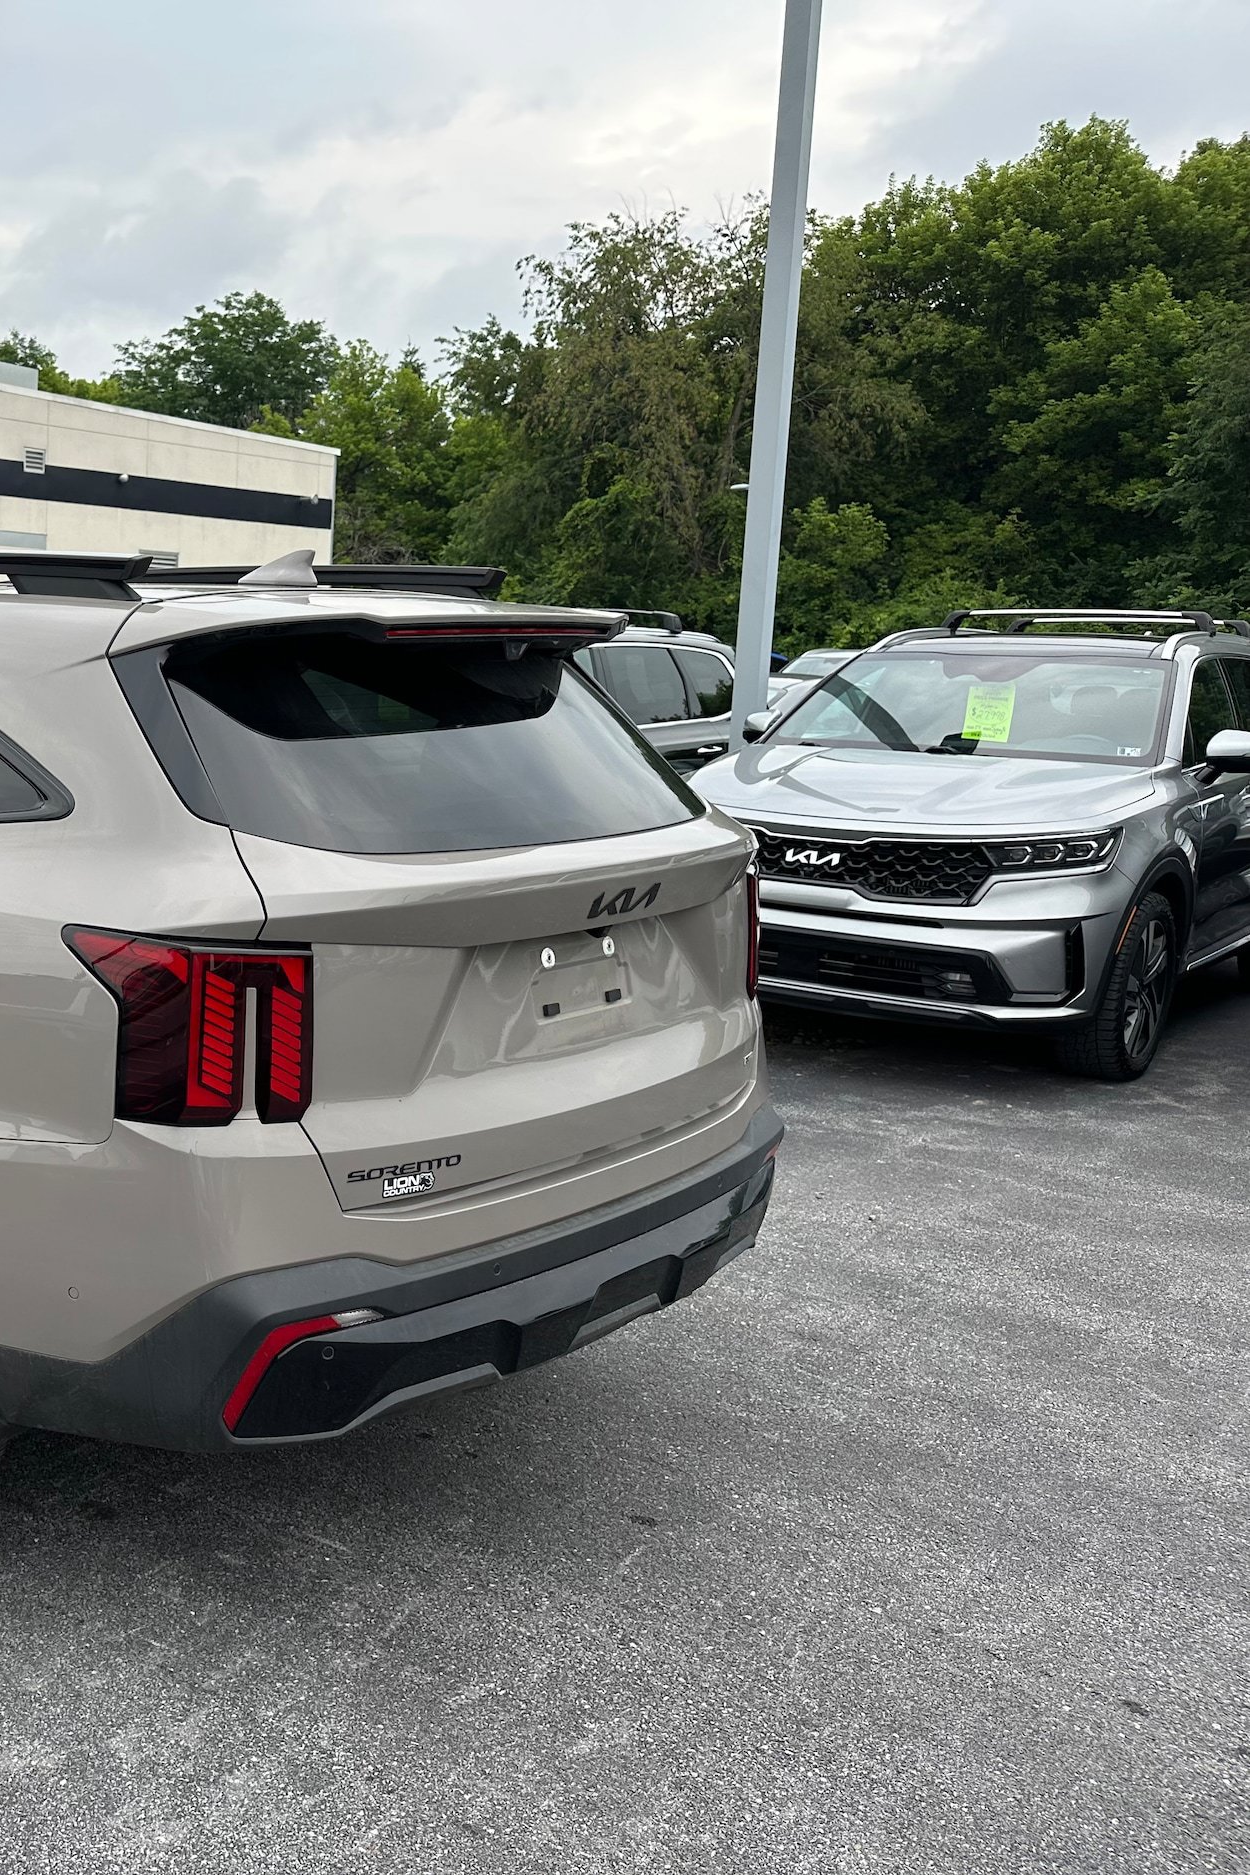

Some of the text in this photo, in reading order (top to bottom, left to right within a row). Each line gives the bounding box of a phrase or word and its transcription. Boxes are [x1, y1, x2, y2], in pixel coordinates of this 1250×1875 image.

[784, 847, 841, 867] KIA
[586, 882, 662, 919] KIA
[347, 1154, 461, 1183] SORENTO
[382, 1185, 425, 1197] COUNTRY
[383, 1175, 420, 1190] LION
